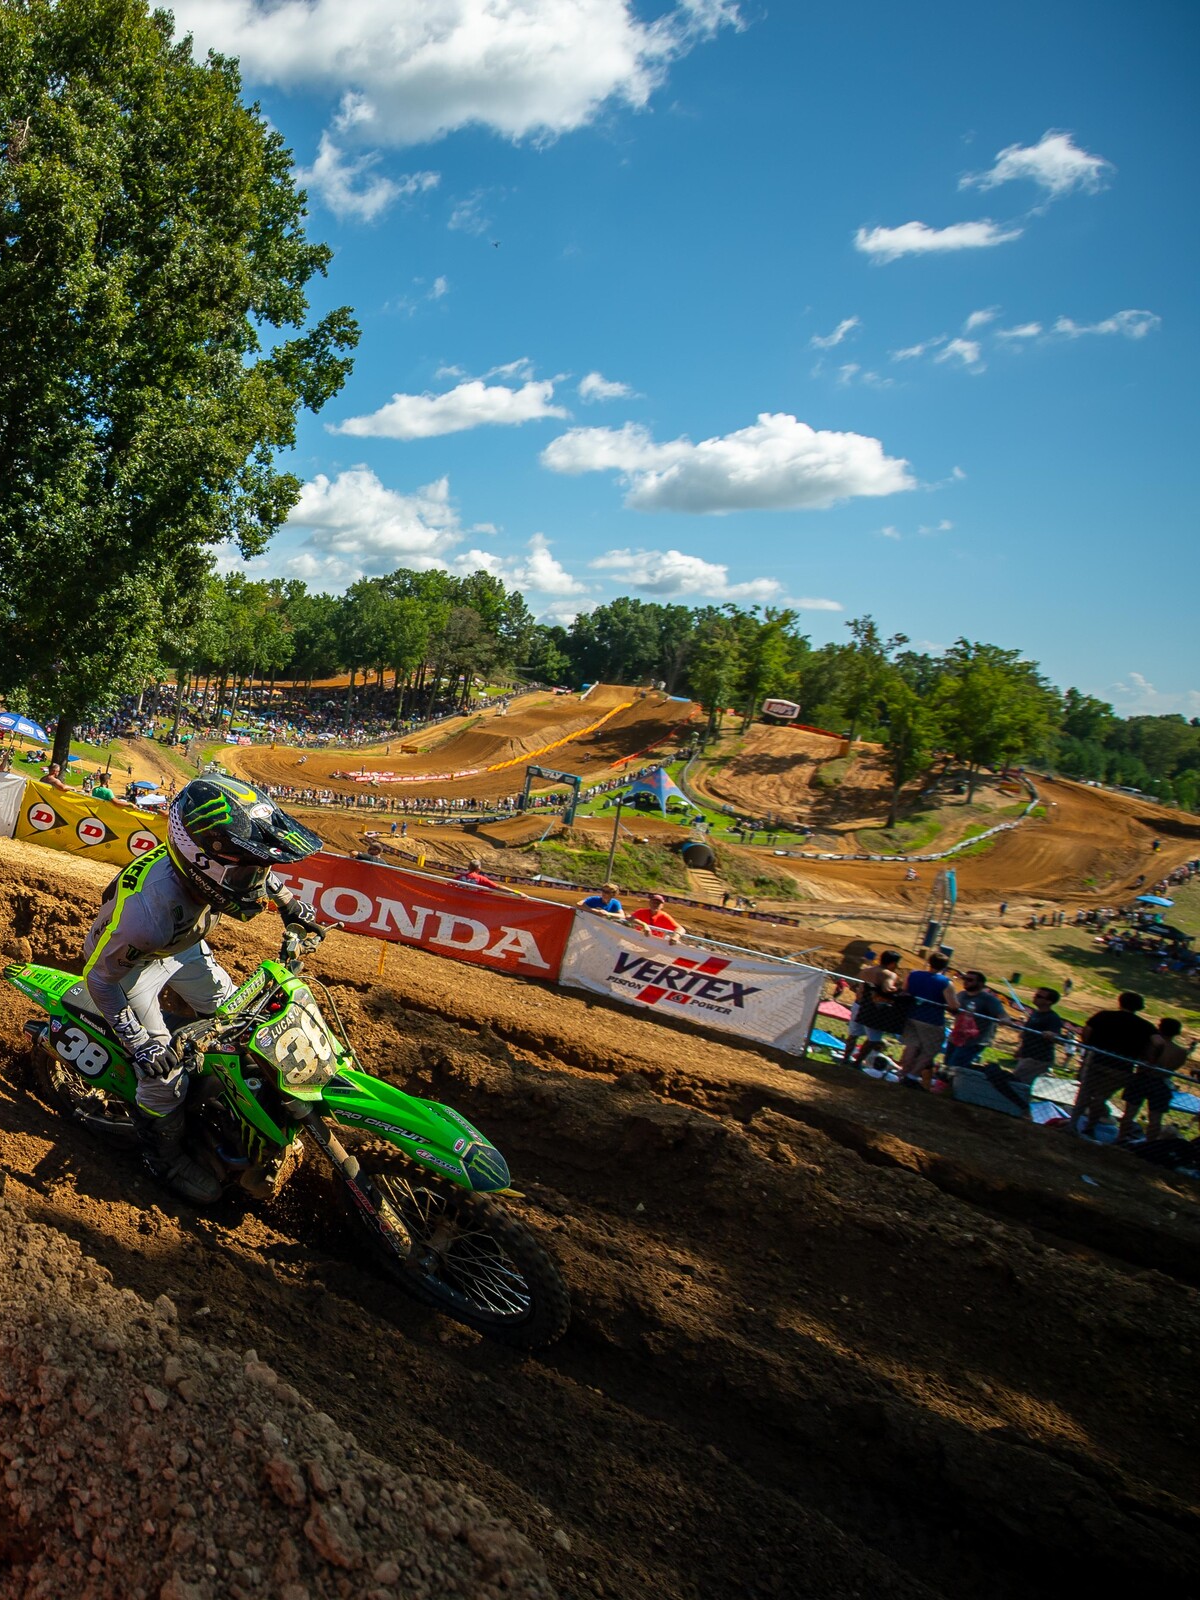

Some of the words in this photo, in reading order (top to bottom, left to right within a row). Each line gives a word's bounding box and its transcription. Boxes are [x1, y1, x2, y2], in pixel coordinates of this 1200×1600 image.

[606, 974, 645, 991] PISTON
[689, 999, 734, 1016] POWER
[613, 951, 763, 1009] VERTEX
[79, 1013, 107, 1036] Kawasaki
[271, 1010, 296, 1040] LUCAS
[274, 1003, 332, 1085] 38
[56, 1027, 110, 1076] 38
[333, 1108, 363, 1121] PRO
[363, 1117, 432, 1145] CIRCUIT
